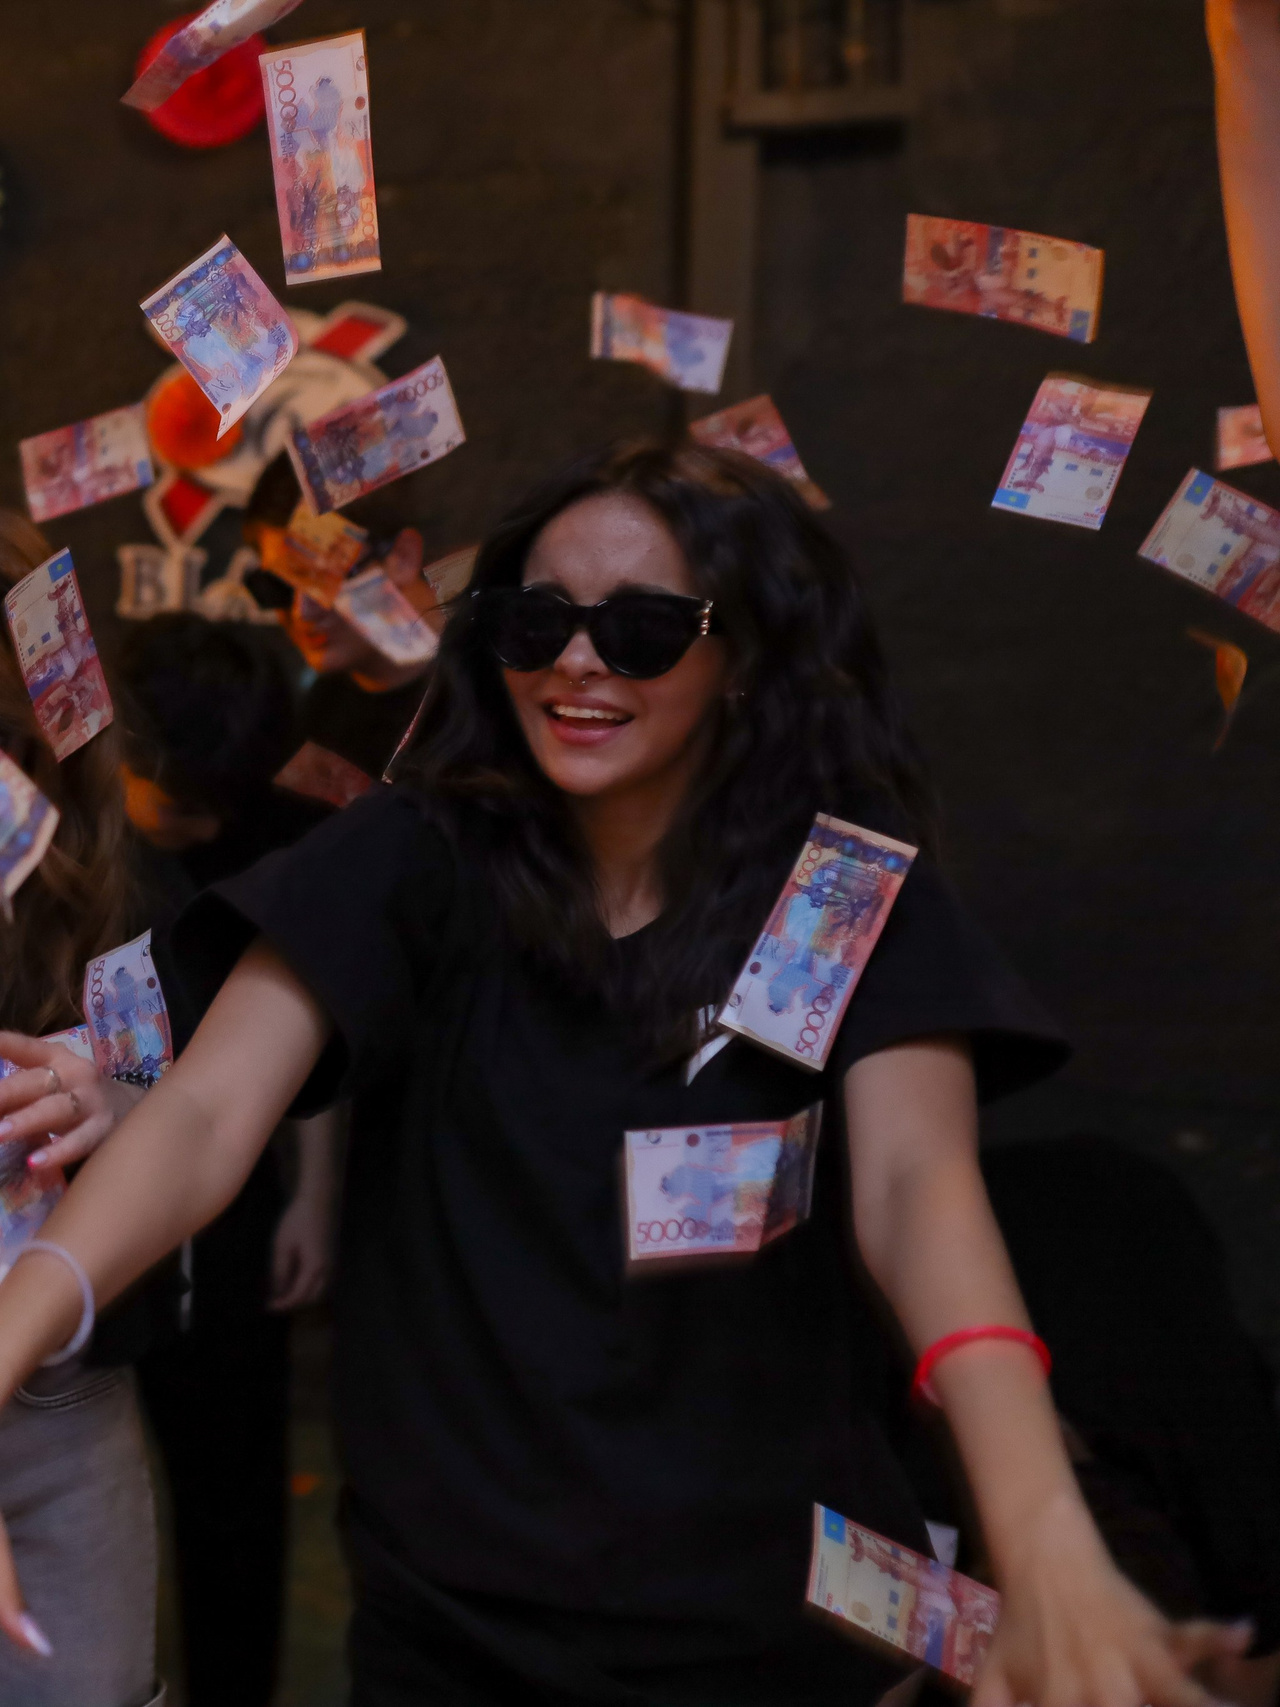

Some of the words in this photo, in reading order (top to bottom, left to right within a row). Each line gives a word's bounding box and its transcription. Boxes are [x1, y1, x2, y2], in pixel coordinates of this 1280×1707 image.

[273, 59, 298, 121] 5000
[90, 959, 105, 1008] 5000
[795, 996, 832, 1058] 5000
[636, 1217, 699, 1244] 5000
